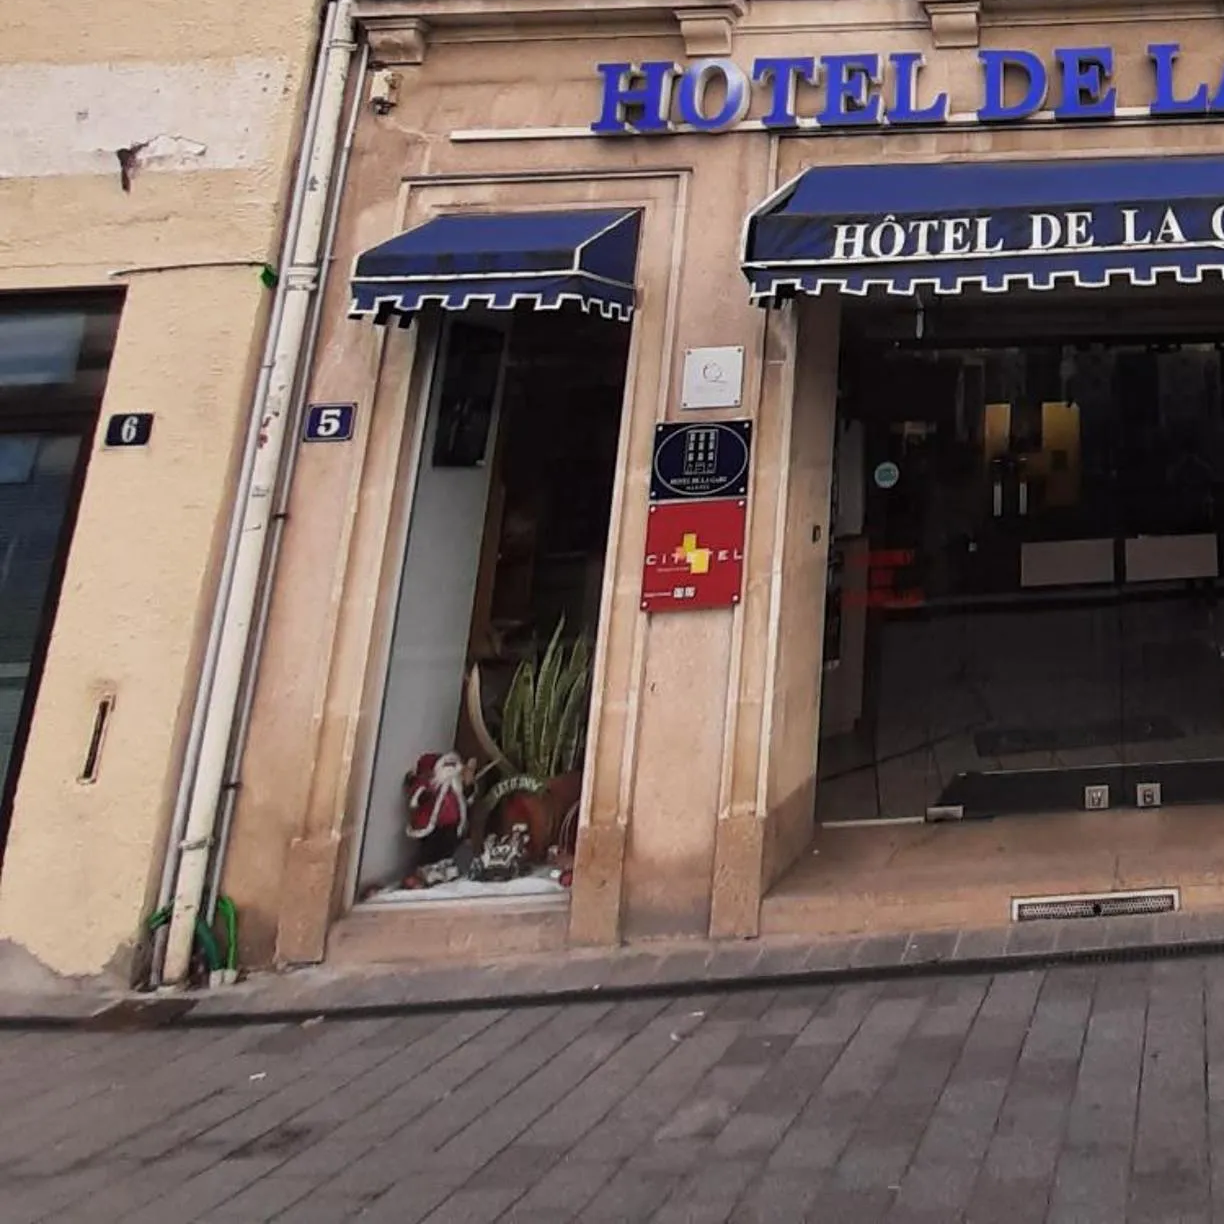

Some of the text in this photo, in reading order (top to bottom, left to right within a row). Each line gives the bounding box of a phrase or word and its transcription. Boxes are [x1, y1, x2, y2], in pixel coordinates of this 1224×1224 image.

[590, 51, 953, 134] HOTEL
[977, 45, 1117, 121] DE
[831, 212, 1004, 260] HÔTEL
[1029, 212, 1095, 251] DE
[1121, 206, 1182, 244] LA
[120, 415, 140, 444] 6
[316, 408, 342, 437] 5
